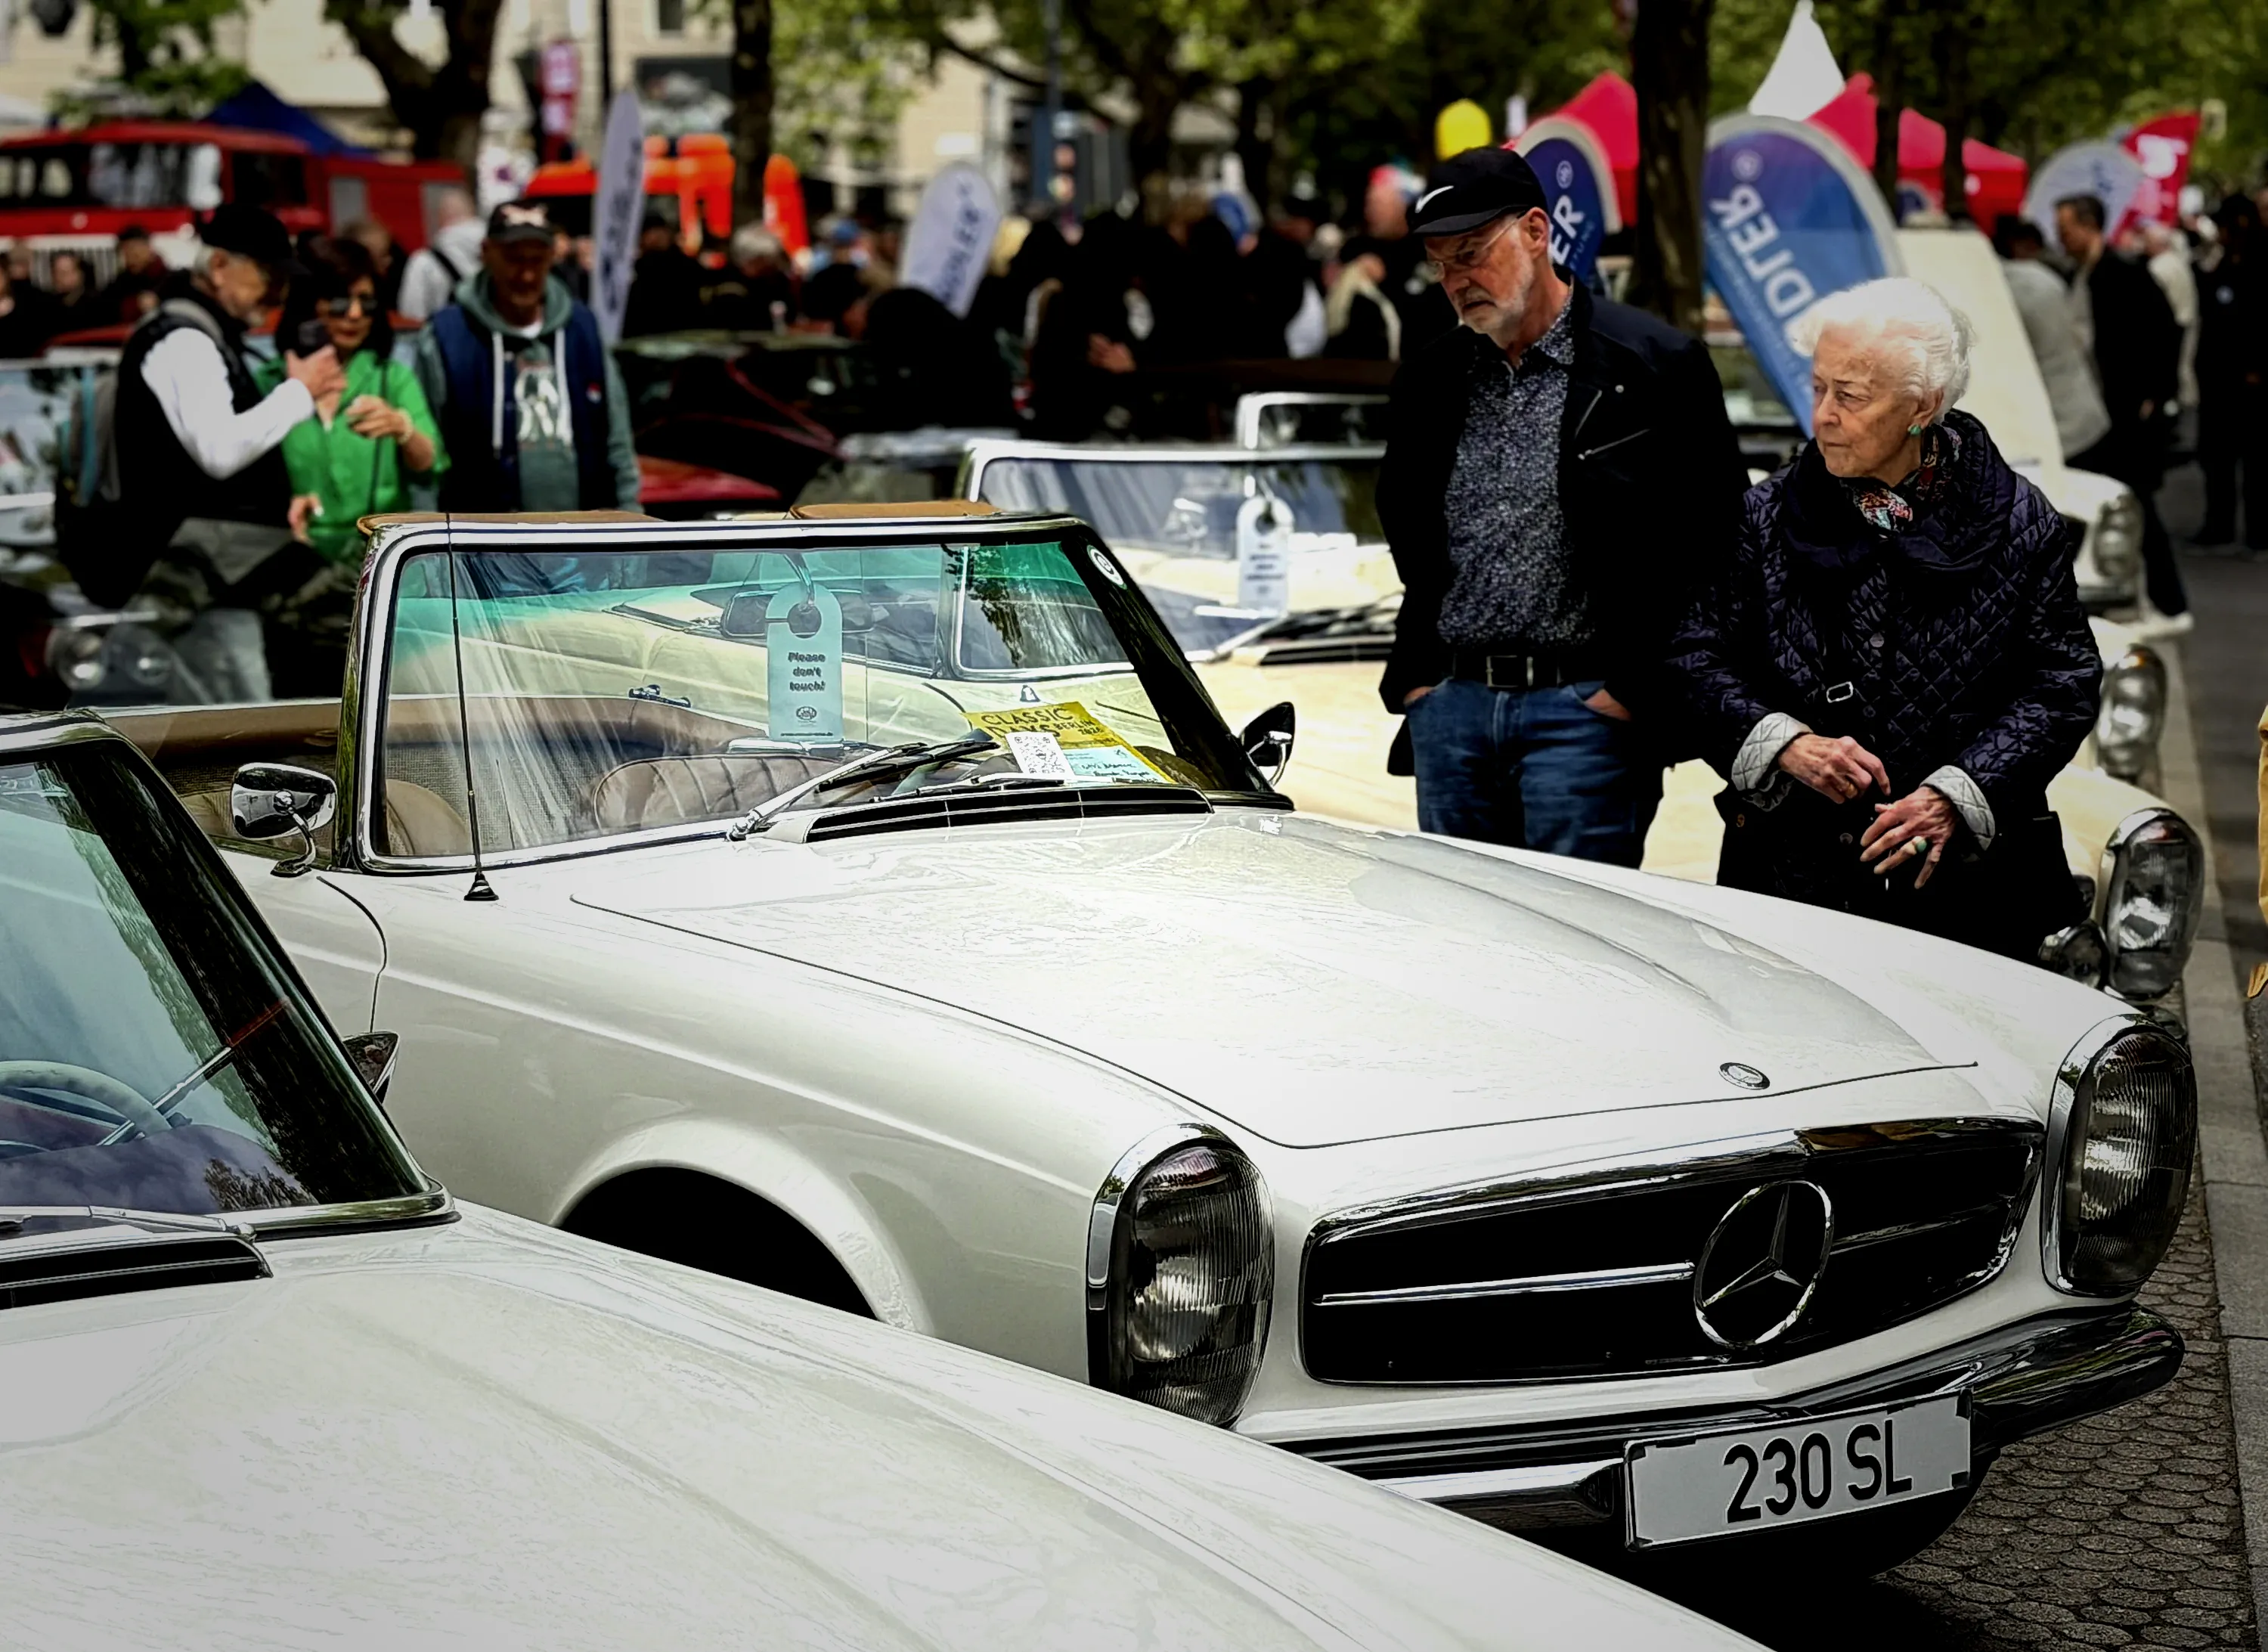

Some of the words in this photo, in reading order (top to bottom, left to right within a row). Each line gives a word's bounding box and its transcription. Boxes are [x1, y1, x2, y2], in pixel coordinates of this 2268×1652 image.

[788, 652, 826, 662] Please
[792, 666, 822, 677] don't
[789, 680, 826, 692] touch!
[981, 708, 1074, 725] CLASSIC
[1052, 720, 1096, 730] BERLIN
[1723, 1433, 1832, 1523] 230
[1847, 1419, 1913, 1501] SL
